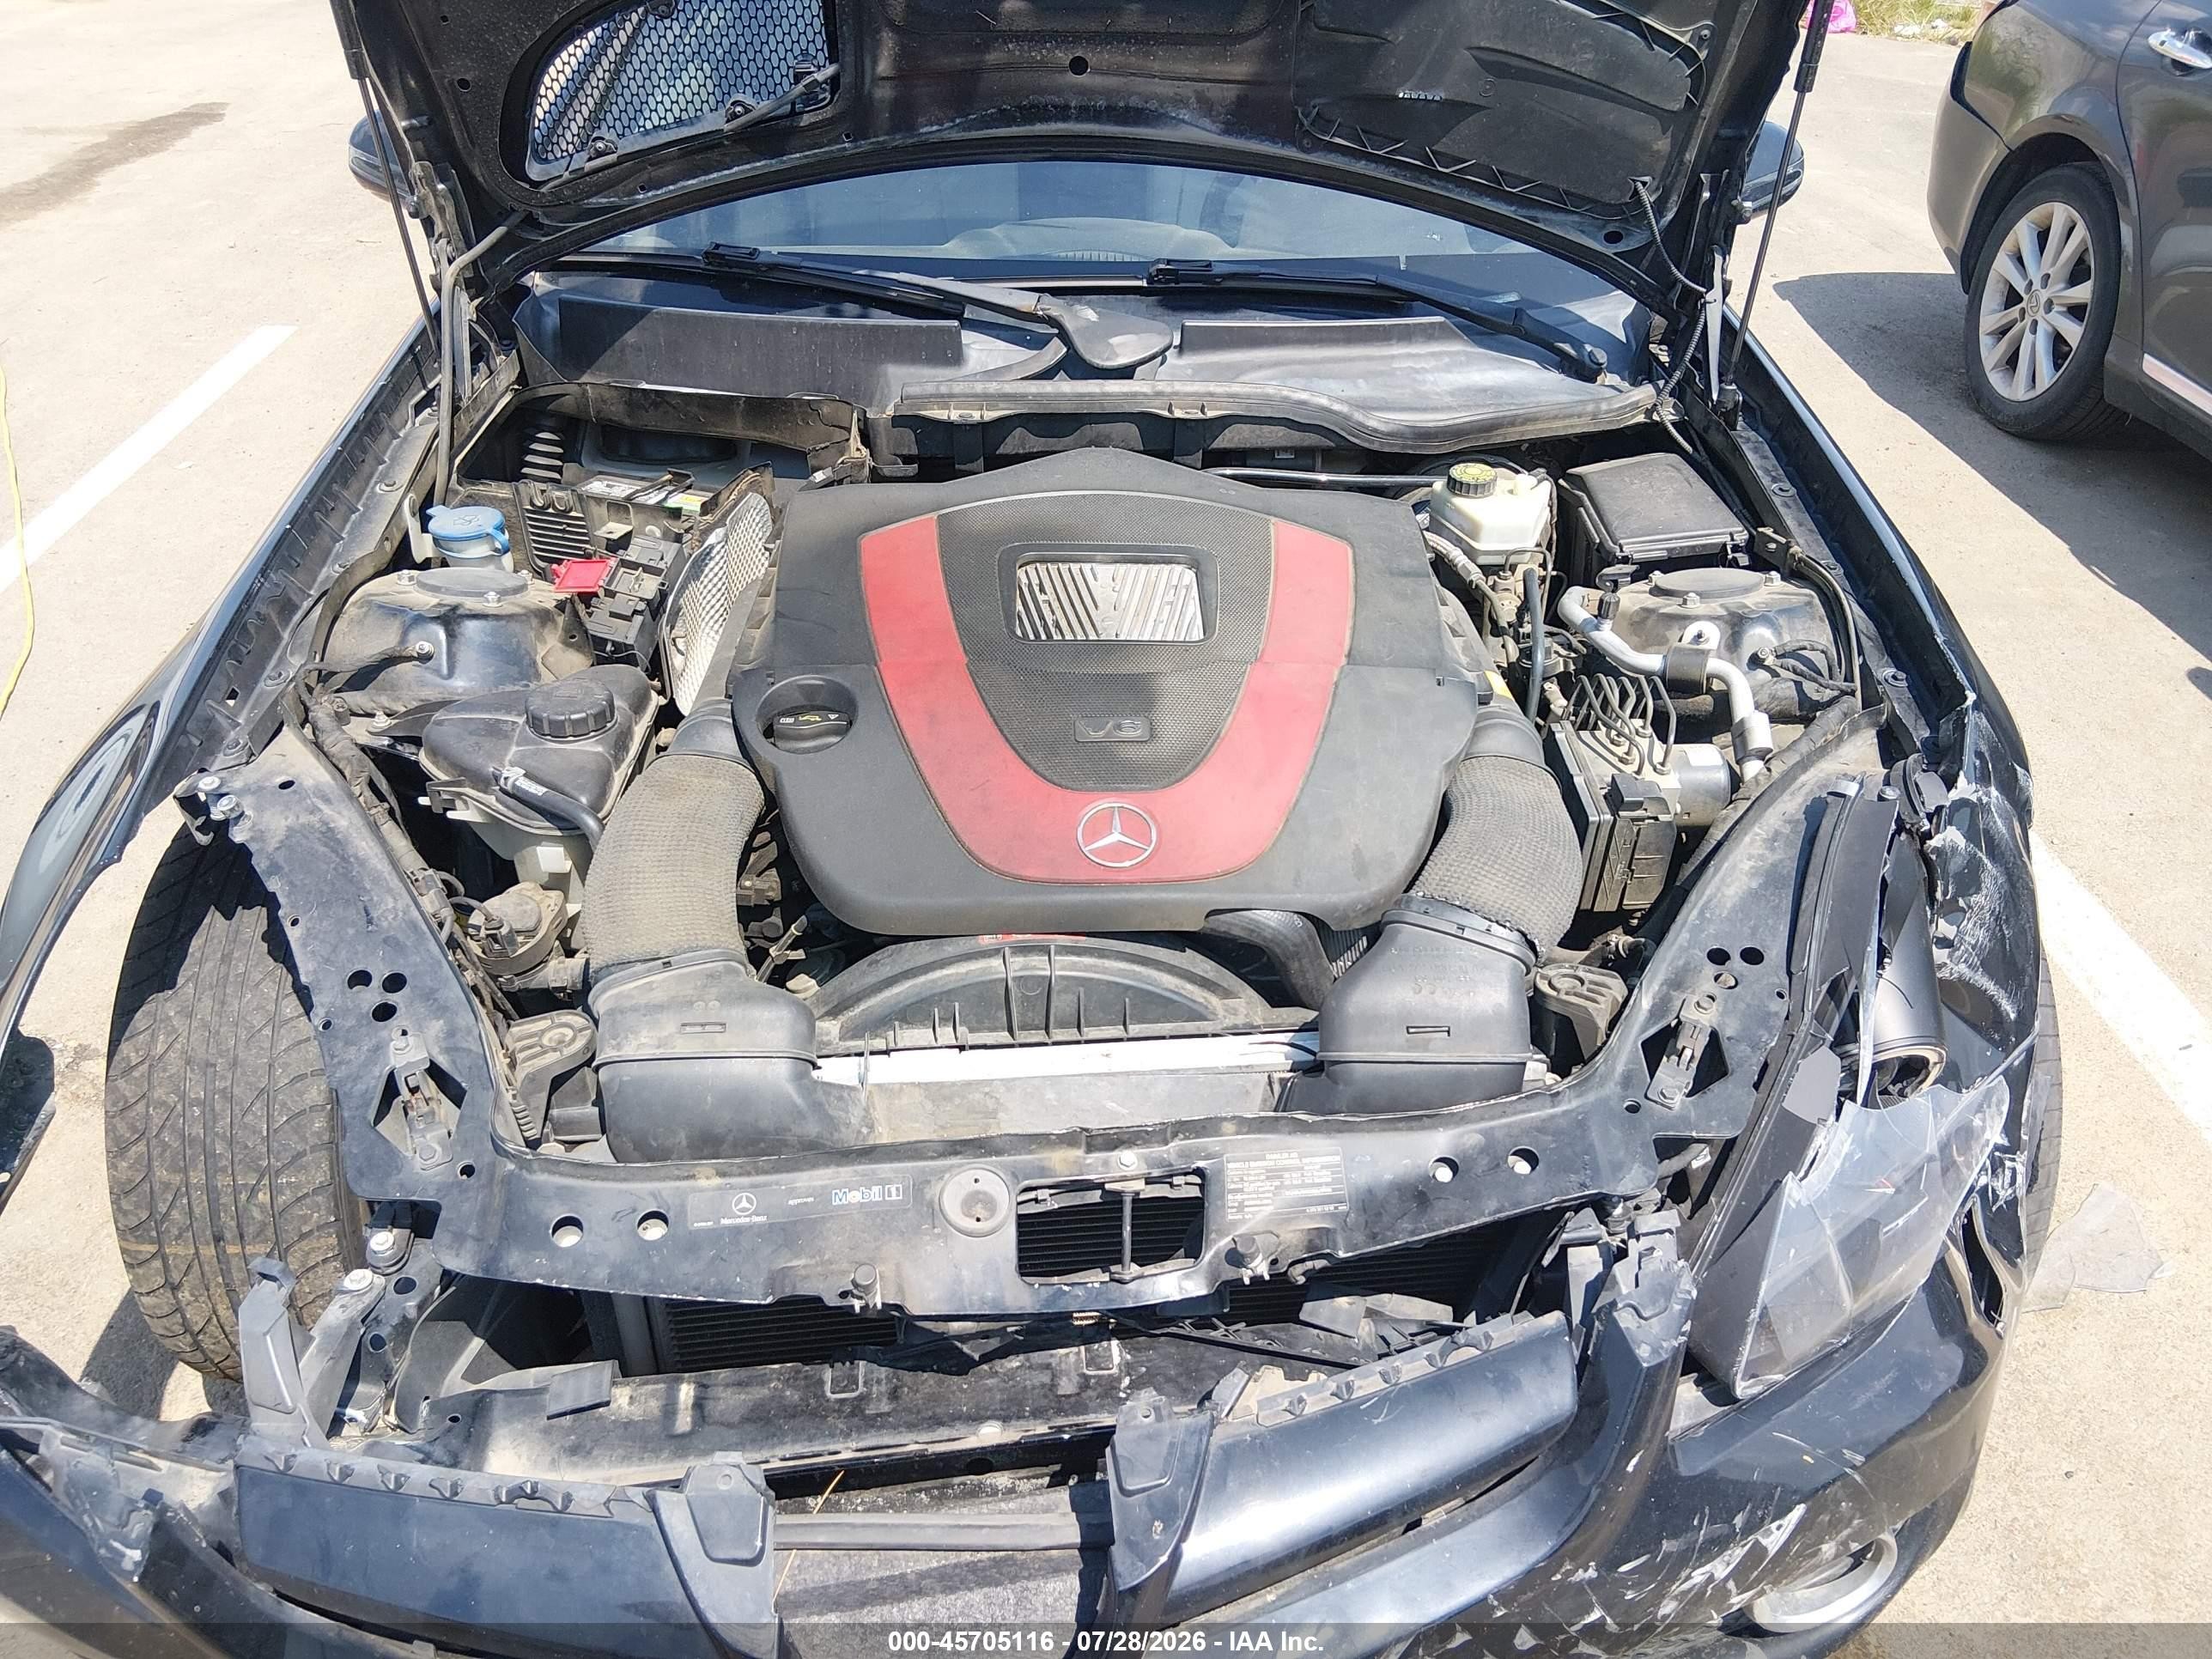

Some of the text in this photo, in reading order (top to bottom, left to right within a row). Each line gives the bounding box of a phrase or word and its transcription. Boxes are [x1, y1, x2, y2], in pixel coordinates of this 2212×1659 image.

[1078, 720, 1142, 737] V6
[832, 1186, 883, 1206] Mobil
[885, 1184, 902, 1200] 1
[720, 1214, 768, 1224] Mercedes-Benz
